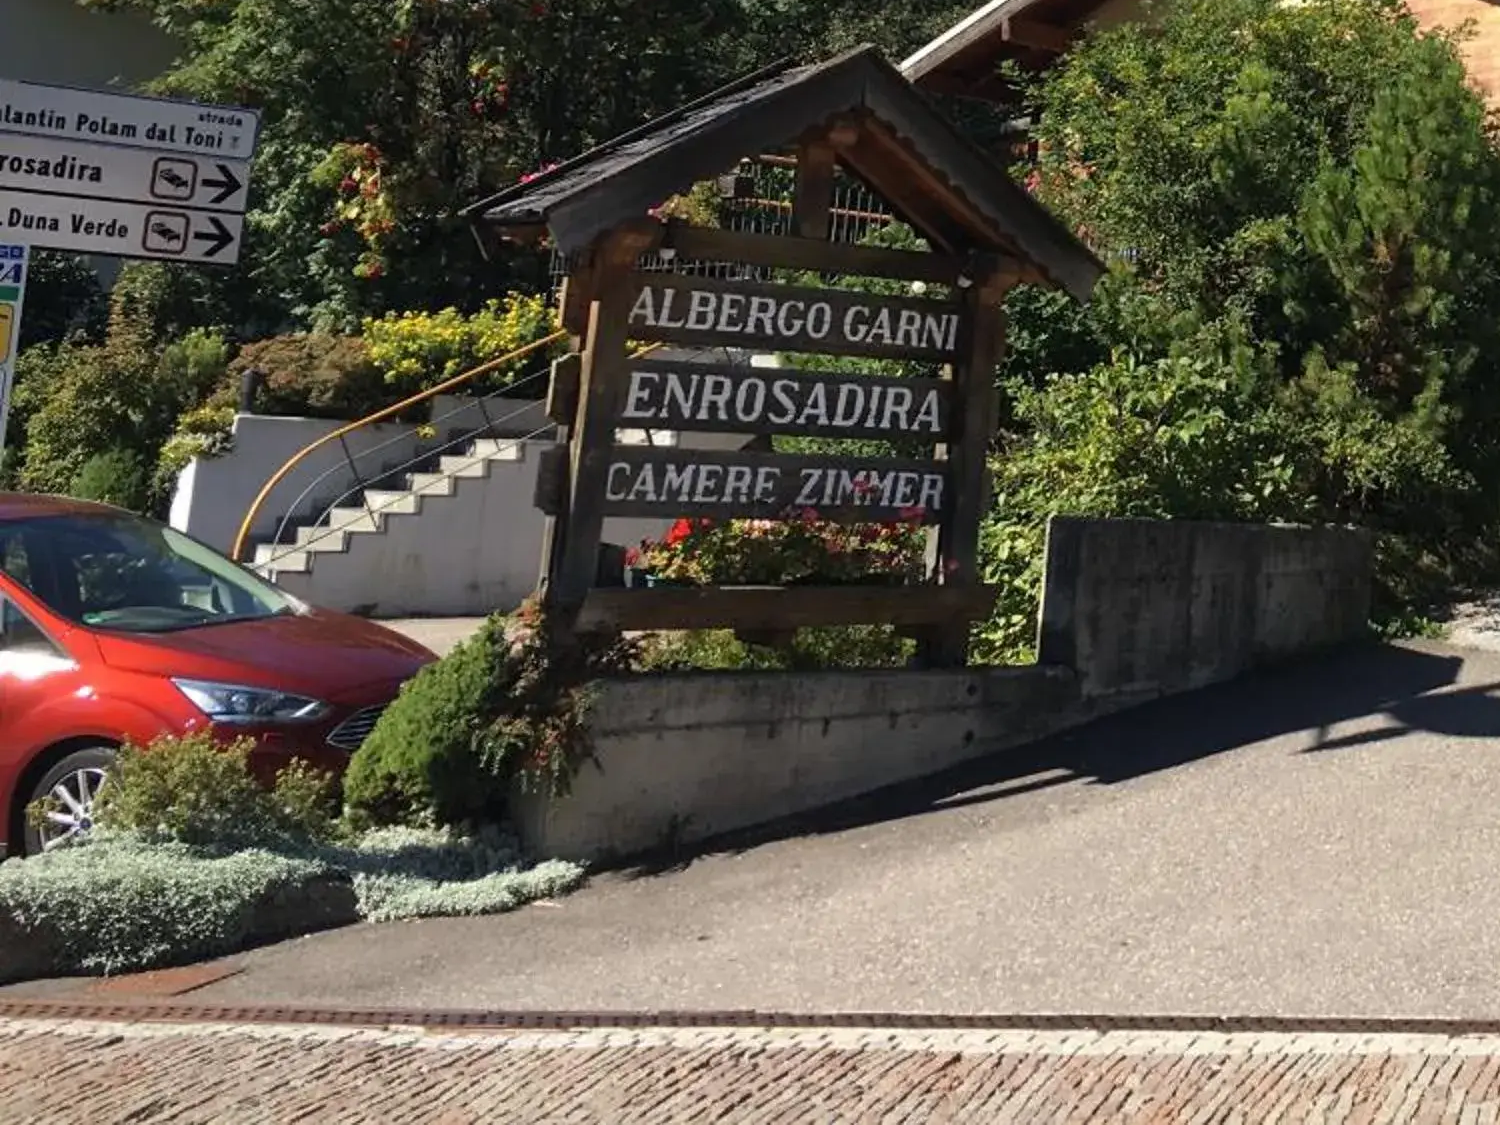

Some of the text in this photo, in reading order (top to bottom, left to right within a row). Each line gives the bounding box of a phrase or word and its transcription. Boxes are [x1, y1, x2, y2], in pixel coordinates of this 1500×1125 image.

[0, 104, 223, 148] lantin Polam dal Toni
[198, 112, 242, 126] strada
[8, 208, 128, 238] Duna Verde
[628, 286, 959, 351] ALBERGO GARNI
[622, 371, 942, 433] ENROSADIRA
[605, 461, 944, 511] CAMERE ZIMMER
